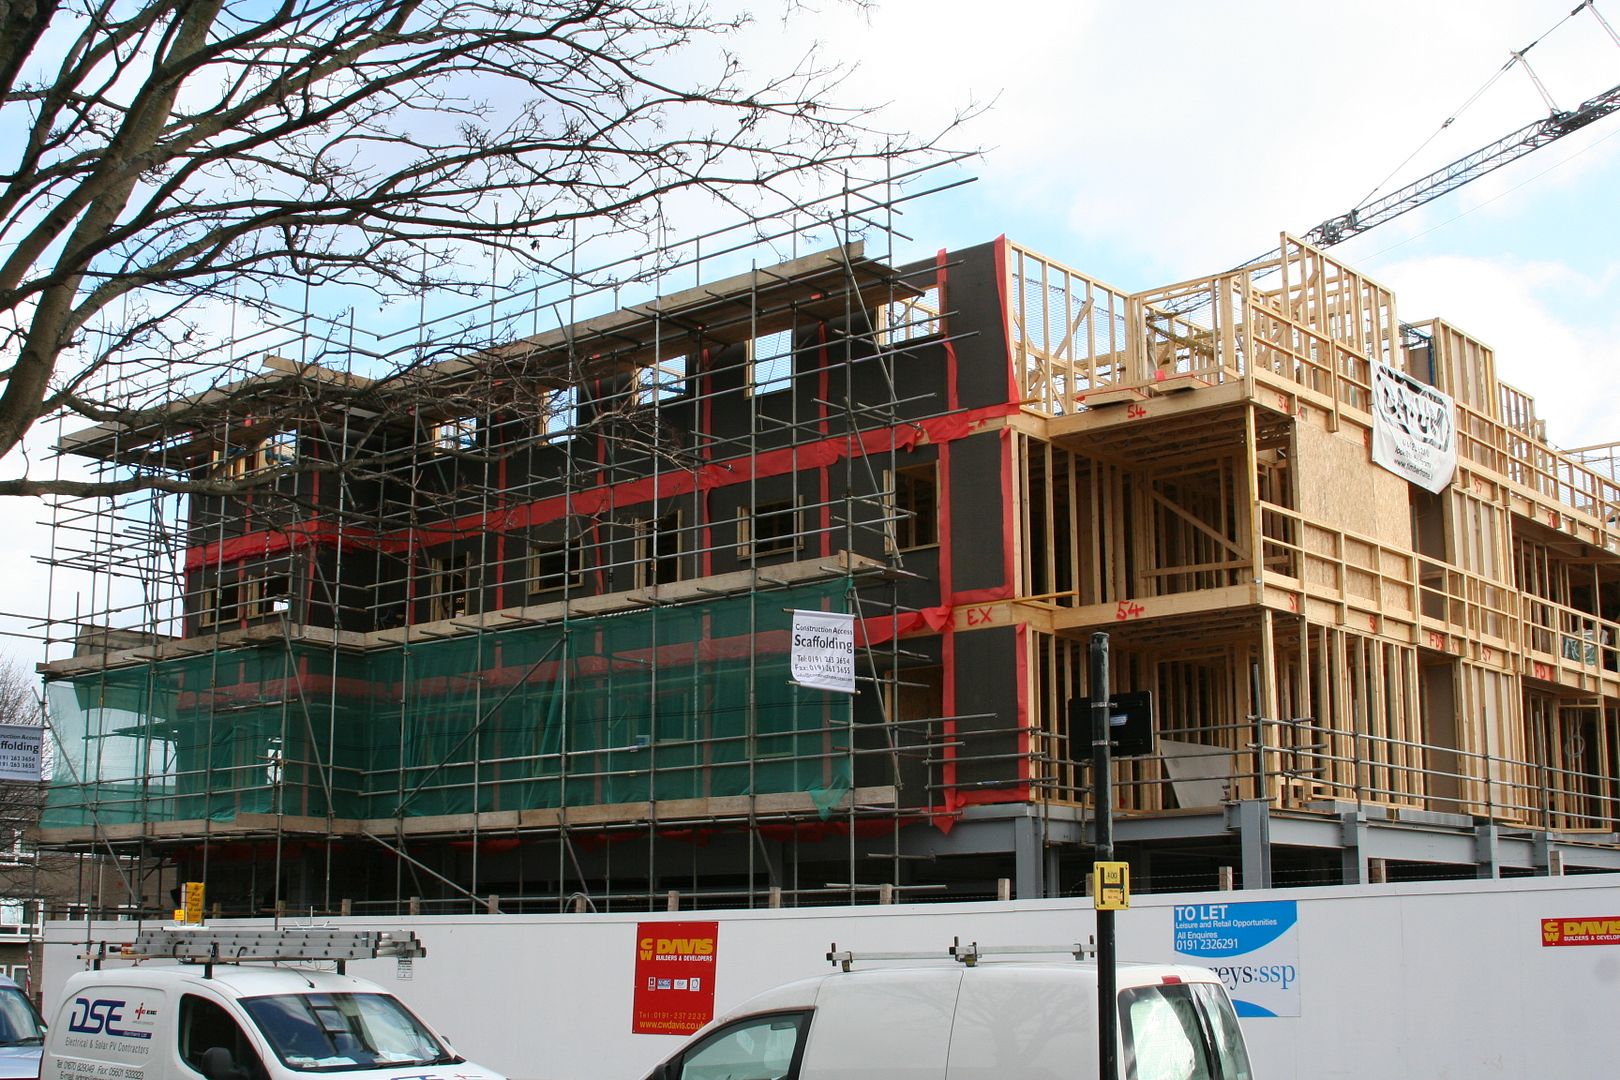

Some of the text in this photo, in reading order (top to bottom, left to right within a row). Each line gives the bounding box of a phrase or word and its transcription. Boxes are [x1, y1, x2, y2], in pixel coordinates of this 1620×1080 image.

[1127, 404, 1146, 419] 54
[967, 606, 993, 626] EX
[1116, 600, 1145, 620] 54
[795, 623, 852, 635] Construction Access
[794, 634, 852, 654] Scaffolding
[1175, 905, 1228, 921] TO LET
[1176, 918, 1278, 929] Leisure and Retail Opportunities
[1176, 938, 1238, 950] 0191 2326291
[1177, 931, 1218, 941] All Enquires
[656, 938, 713, 955] DAVIS
[69, 998, 152, 1039] DSE
[639, 1020, 705, 1030] www.cwdavis.co.uk
[65, 1037, 89, 1048] Electrical
[95, 1040, 108, 1050] Solar
[109, 1041, 118, 1051] PV
[118, 1042, 149, 1055] Contractors
